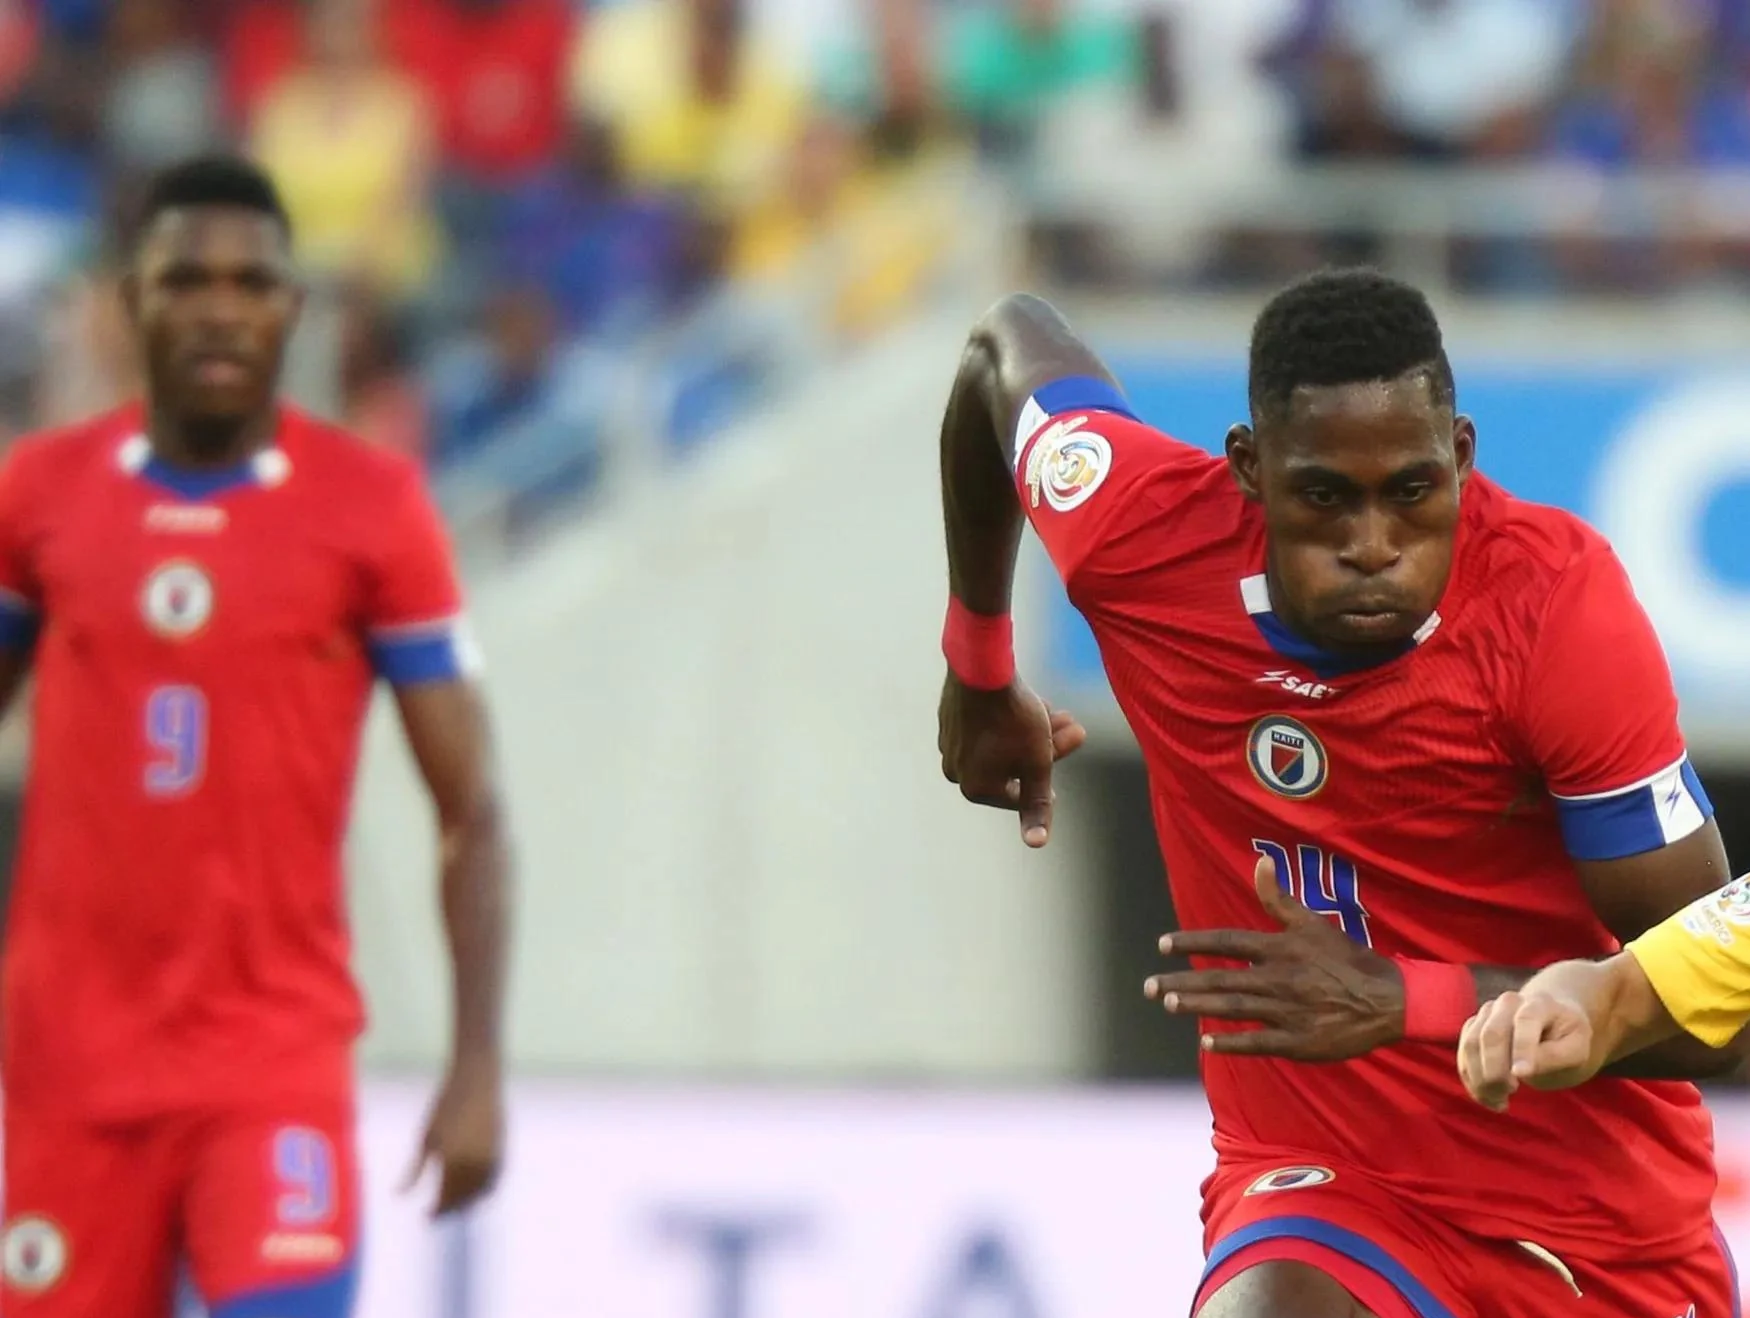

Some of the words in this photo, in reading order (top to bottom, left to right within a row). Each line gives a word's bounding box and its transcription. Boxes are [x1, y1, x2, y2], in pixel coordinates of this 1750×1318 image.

[143, 684, 208, 794] 9
[1273, 731, 1301, 747] HAITI
[1251, 838, 1373, 949] 14
[273, 1126, 337, 1225] 9
